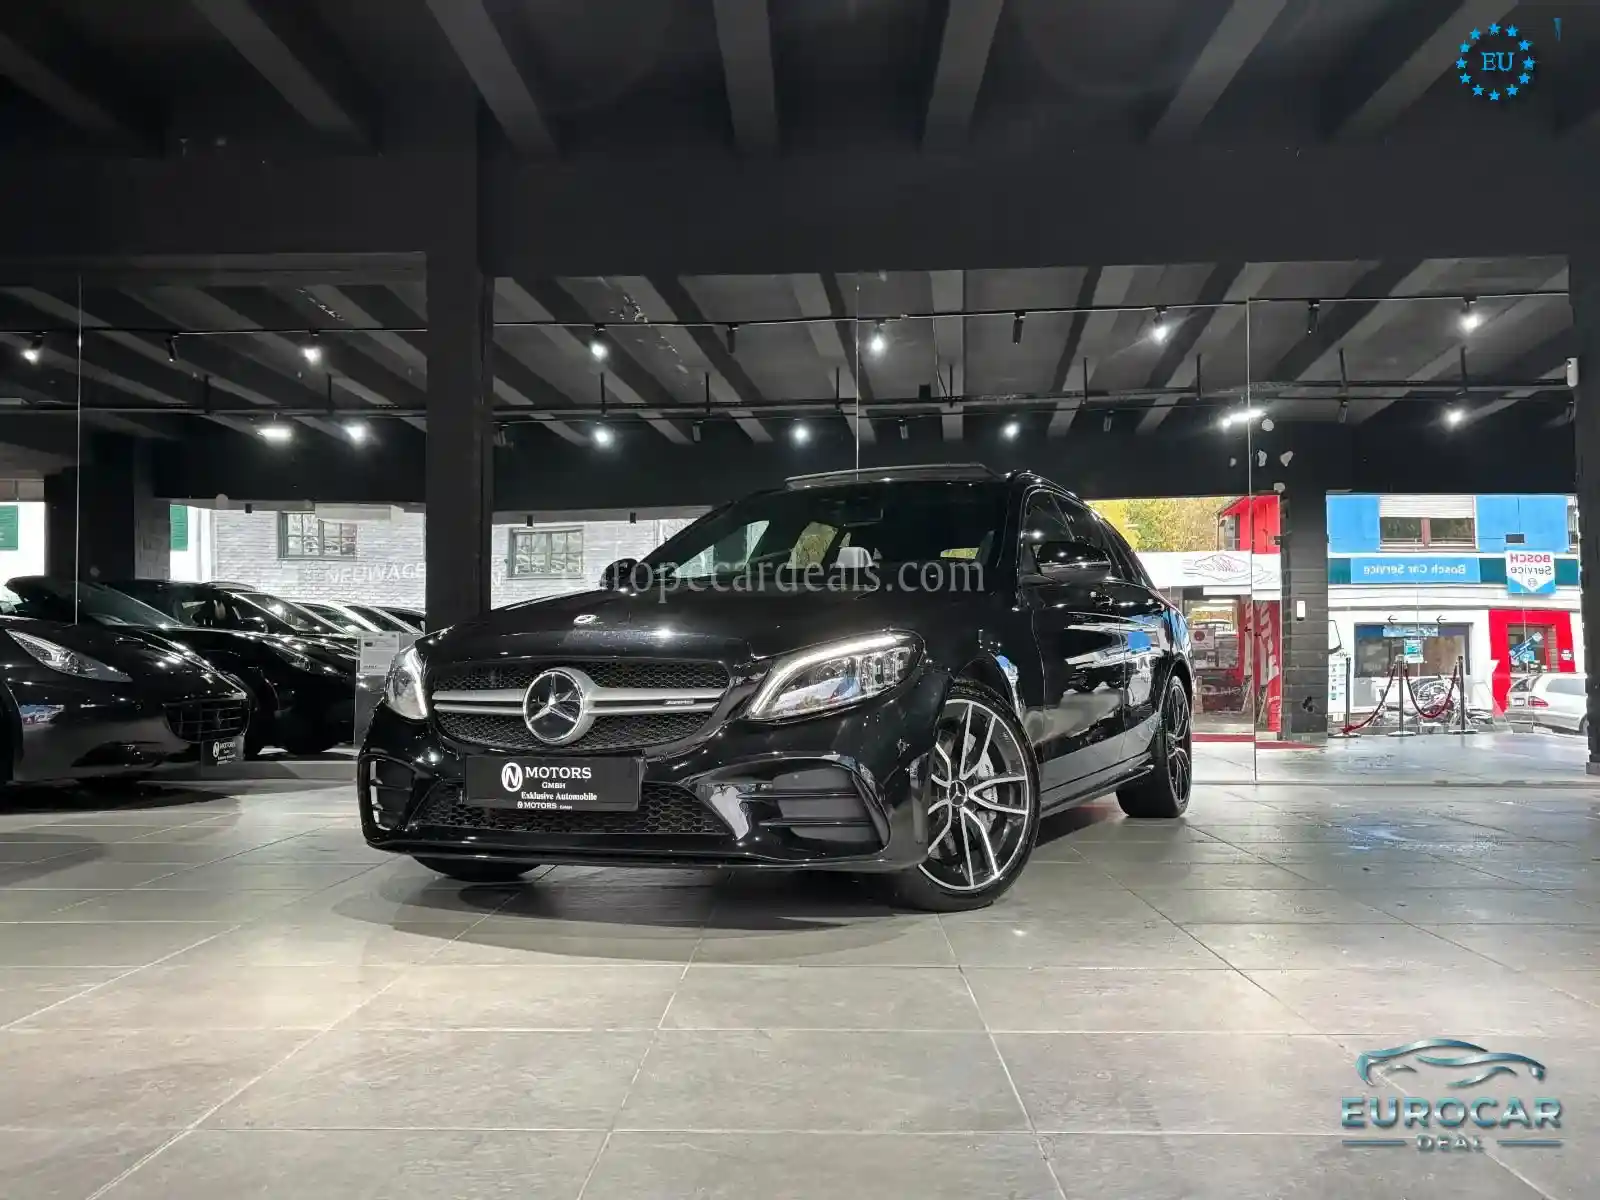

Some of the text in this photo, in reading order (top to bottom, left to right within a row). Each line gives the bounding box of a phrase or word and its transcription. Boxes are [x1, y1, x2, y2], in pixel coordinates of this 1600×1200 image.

[525, 766, 592, 780] MOTORS
[521, 791, 598, 802] Exklusive Automobile
[524, 801, 558, 810] MOTORS
